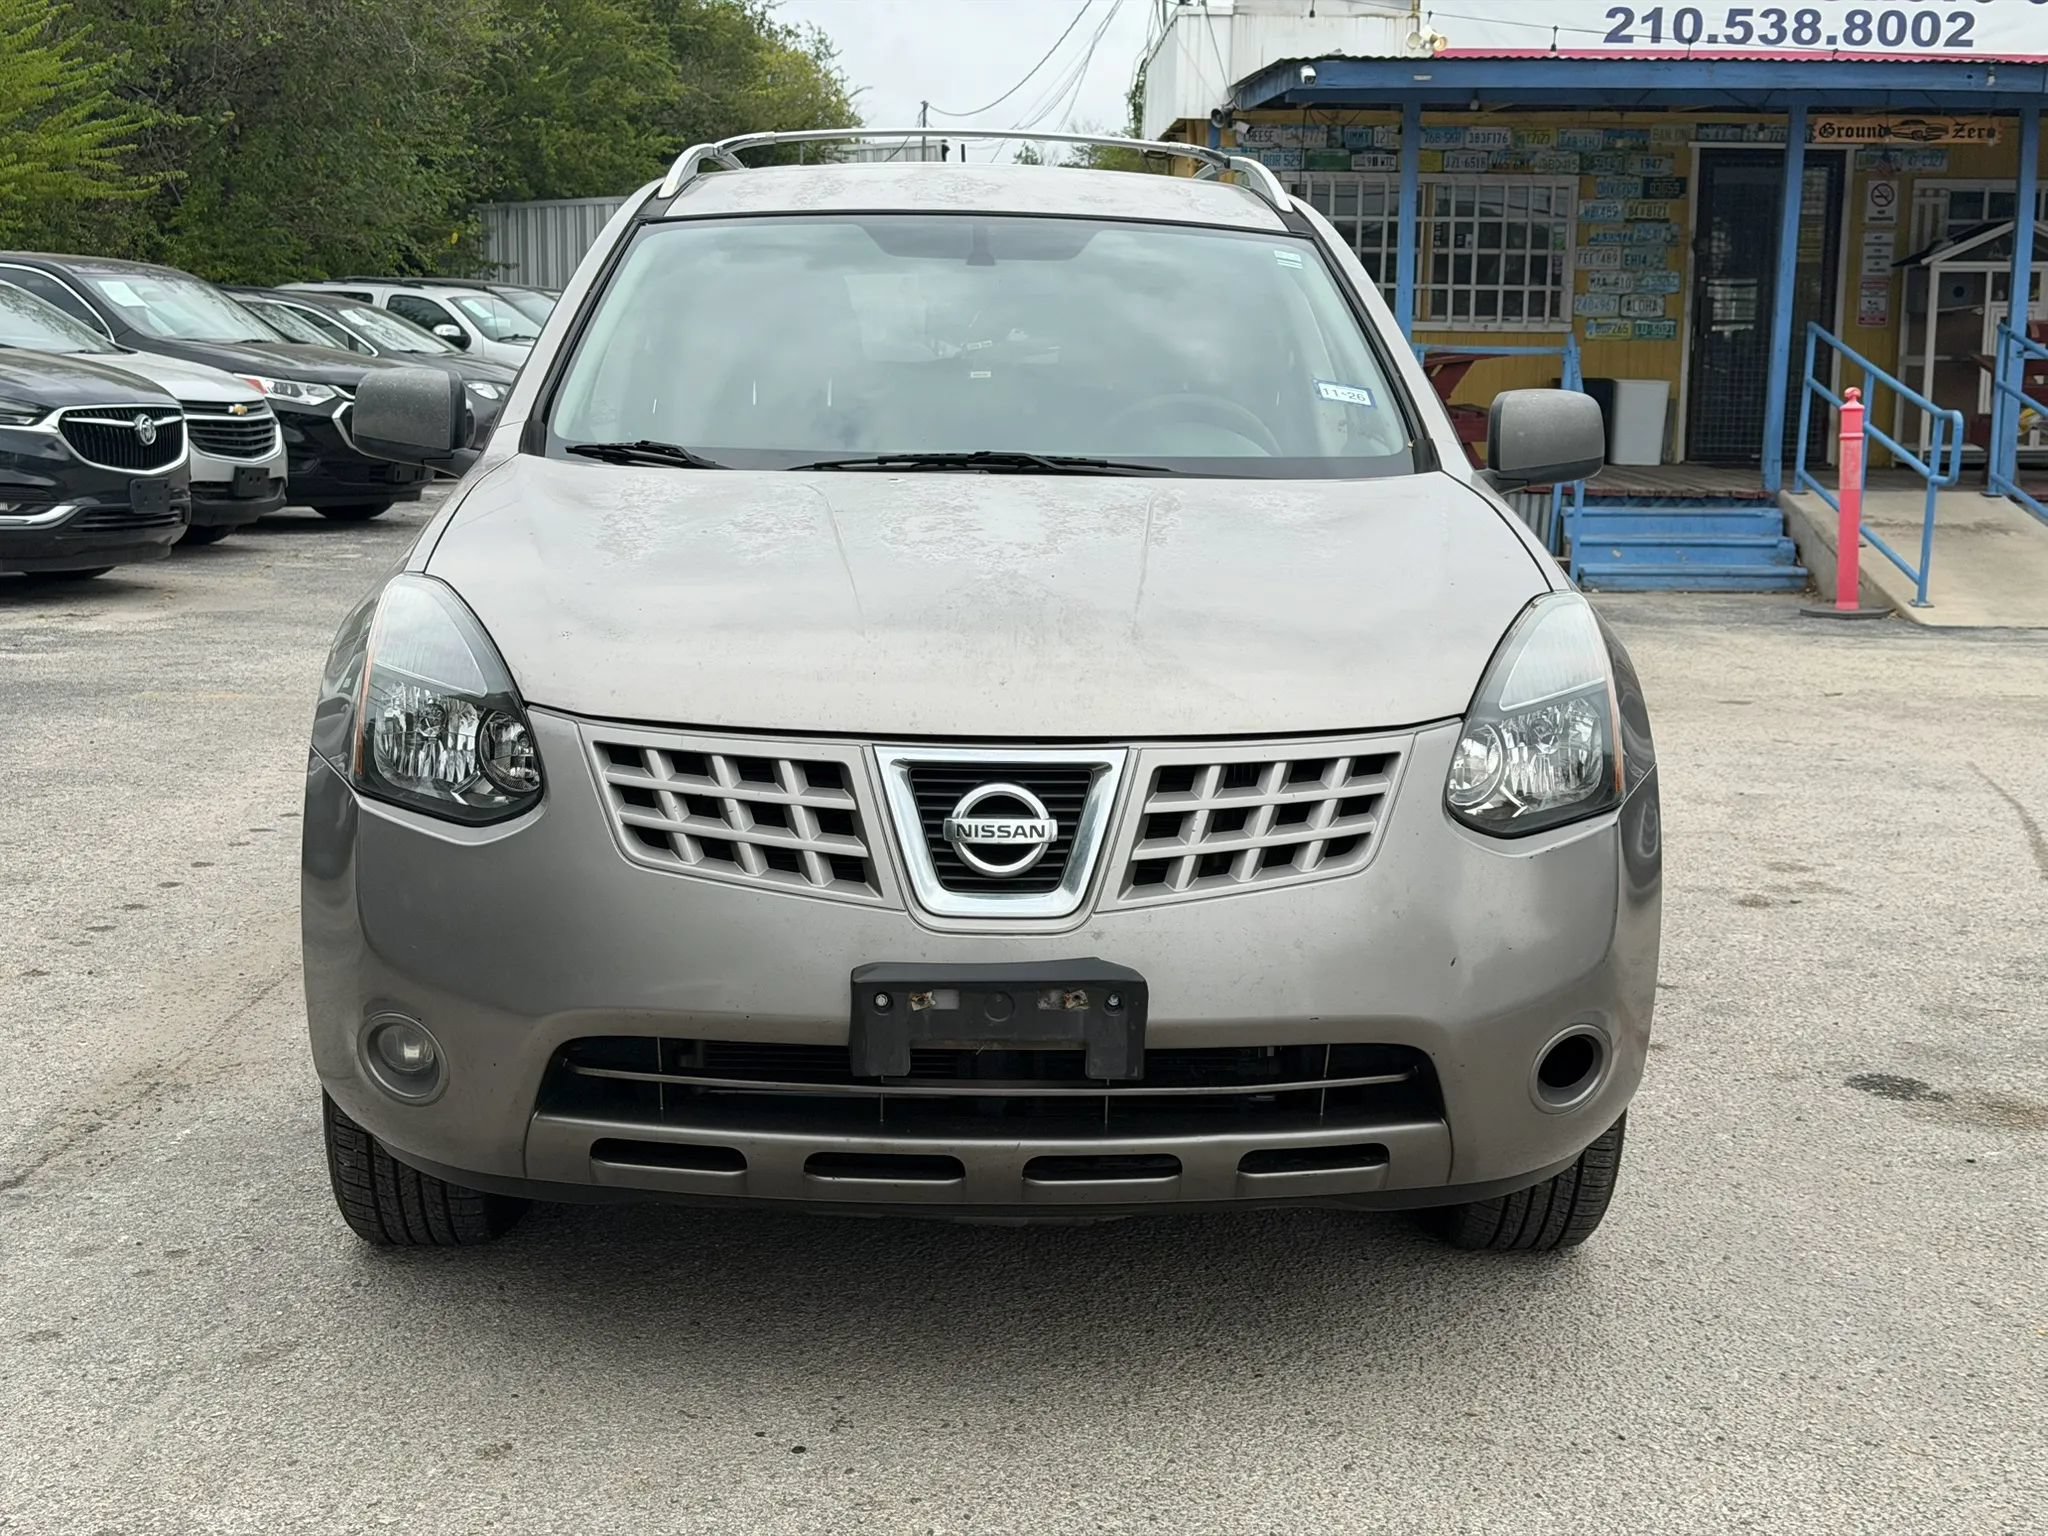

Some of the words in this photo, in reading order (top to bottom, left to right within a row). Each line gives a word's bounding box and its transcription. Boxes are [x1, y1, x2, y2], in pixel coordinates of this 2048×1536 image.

[1602, 6, 1975, 47] 210.538.8002
[1819, 122, 1889, 139] Ground
[1625, 299, 1658, 312] ALOHA
[1323, 388, 1366, 401] 11-26
[956, 824, 1045, 838] NISSAN
